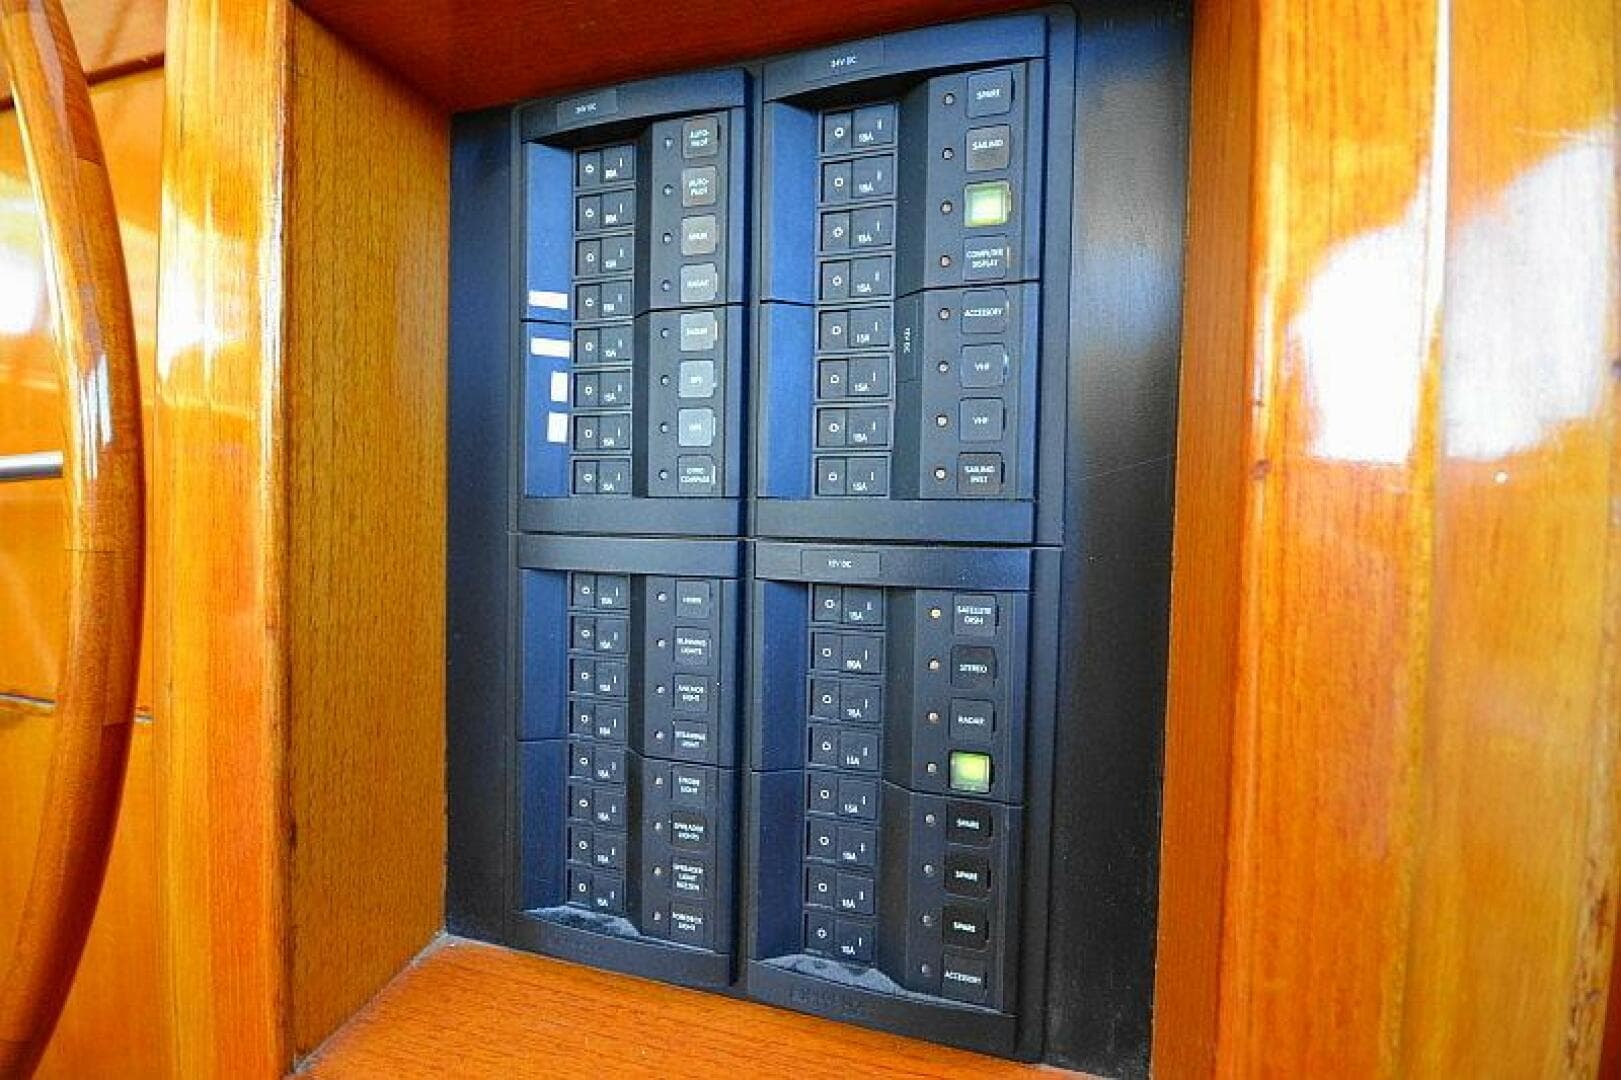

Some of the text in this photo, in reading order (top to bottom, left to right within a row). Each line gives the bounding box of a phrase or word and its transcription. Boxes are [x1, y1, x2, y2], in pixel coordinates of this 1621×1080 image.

[831, 56, 857, 68] 24V DC
[966, 248, 1004, 259] COMPUTER
[964, 307, 1004, 317] ACCESSORY
[974, 362, 990, 372] VHF
[972, 416, 989, 425] VHF
[964, 615, 984, 625] DISH
[959, 663, 988, 674] STEREO
[944, 969, 982, 984] ACCESSORY
